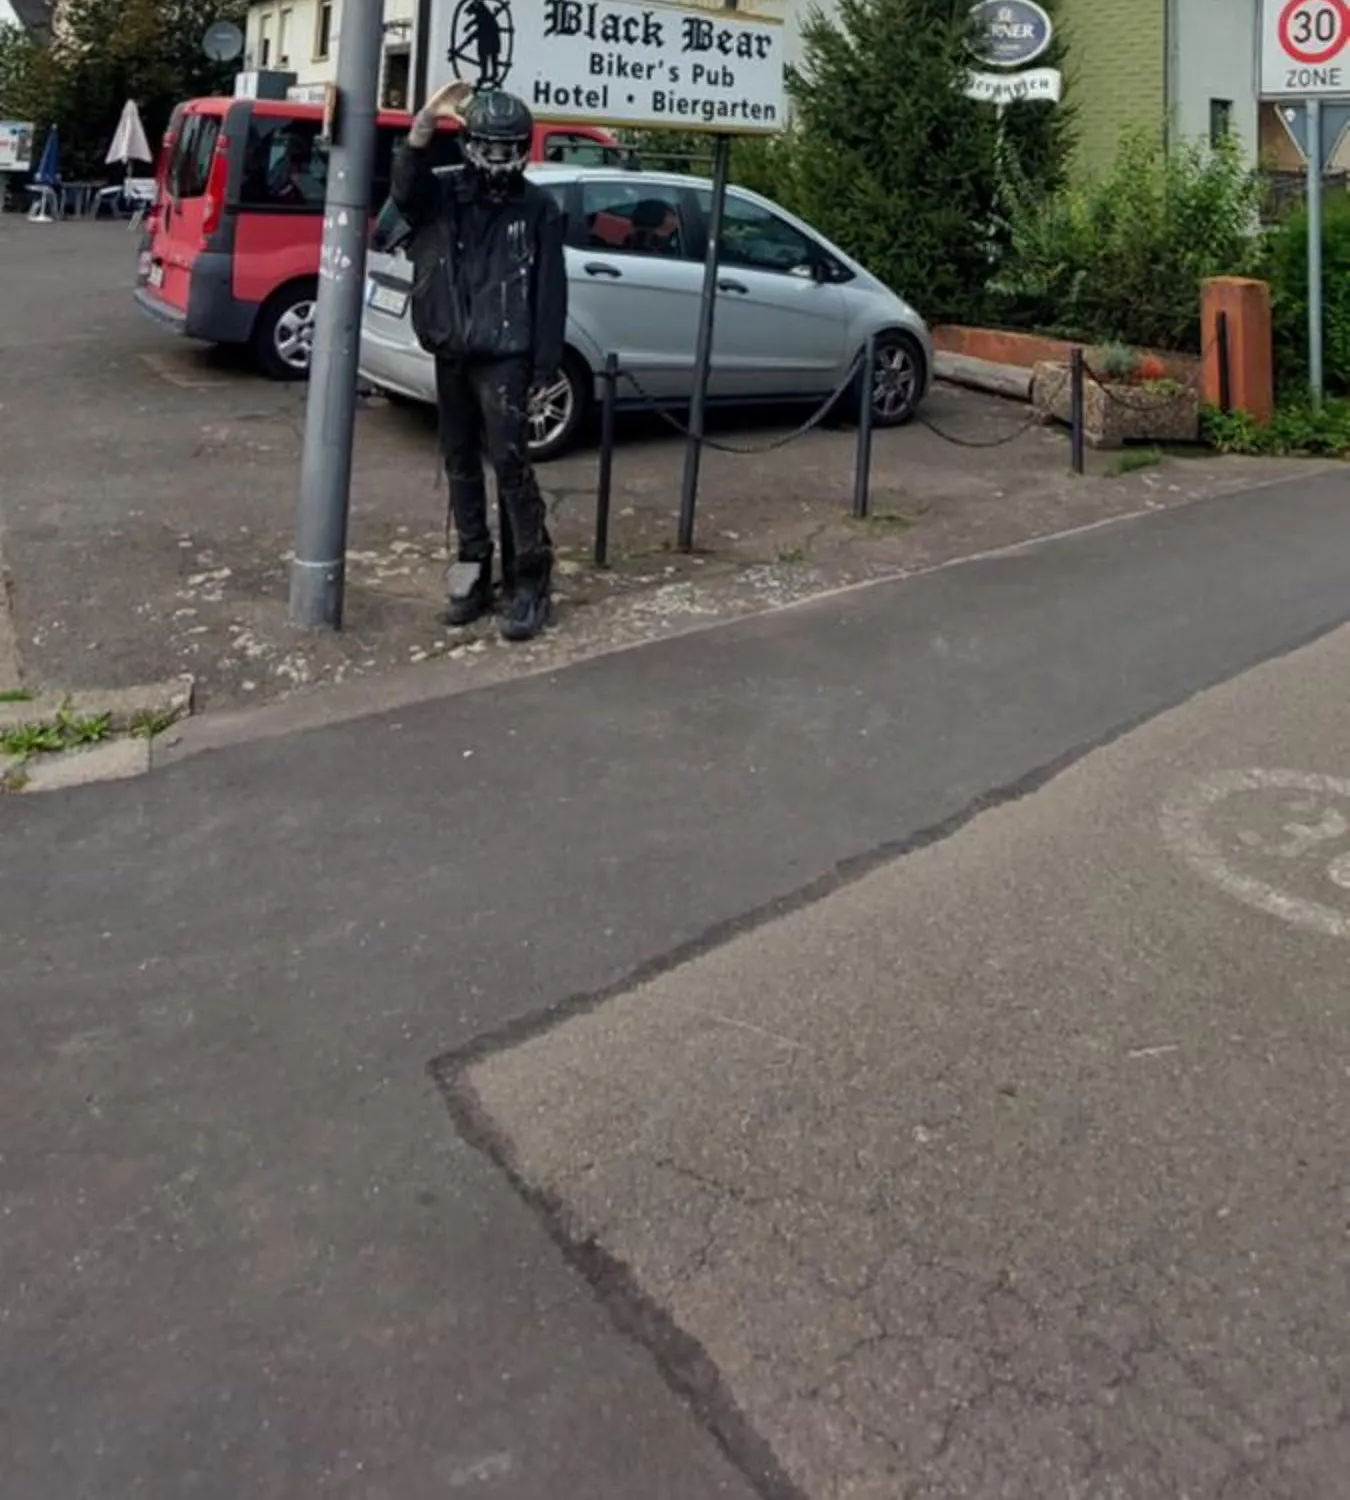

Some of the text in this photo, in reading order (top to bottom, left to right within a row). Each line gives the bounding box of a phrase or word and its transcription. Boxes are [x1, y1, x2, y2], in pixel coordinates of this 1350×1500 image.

[681, 17, 773, 60] Bear
[1293, 8, 1336, 44] 30
[589, 52, 736, 88] Biker's Pub
[1285, 67, 1343, 89] ZONE
[533, 80, 777, 123] Hotel Biergarten
